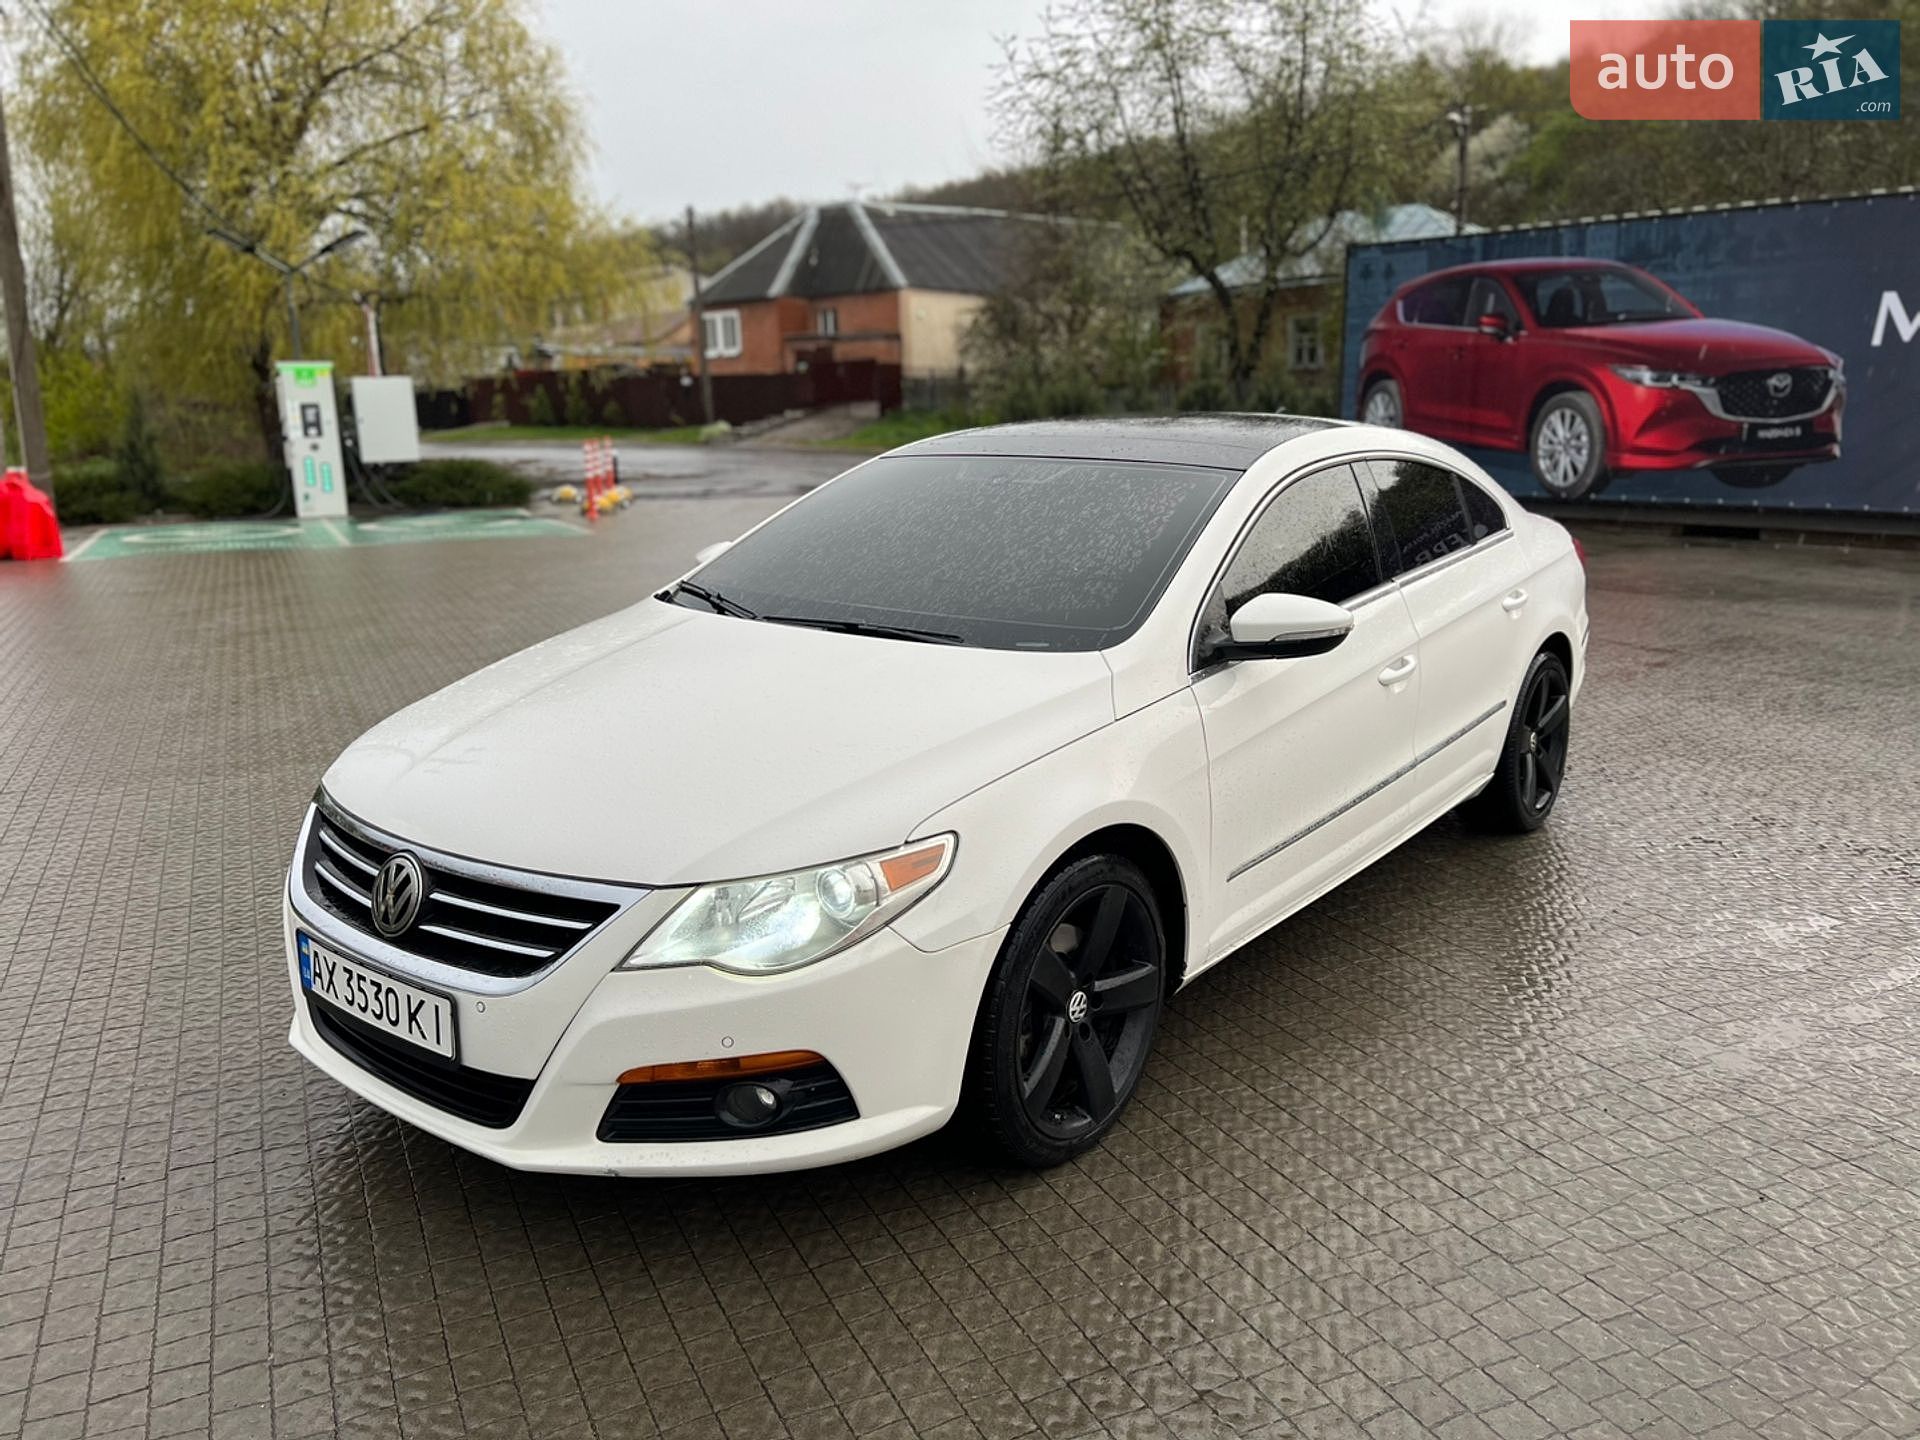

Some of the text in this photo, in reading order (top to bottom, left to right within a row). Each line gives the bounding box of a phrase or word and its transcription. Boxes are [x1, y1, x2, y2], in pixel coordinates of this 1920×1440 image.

[312, 950, 442, 1046] AX 3530 KI
